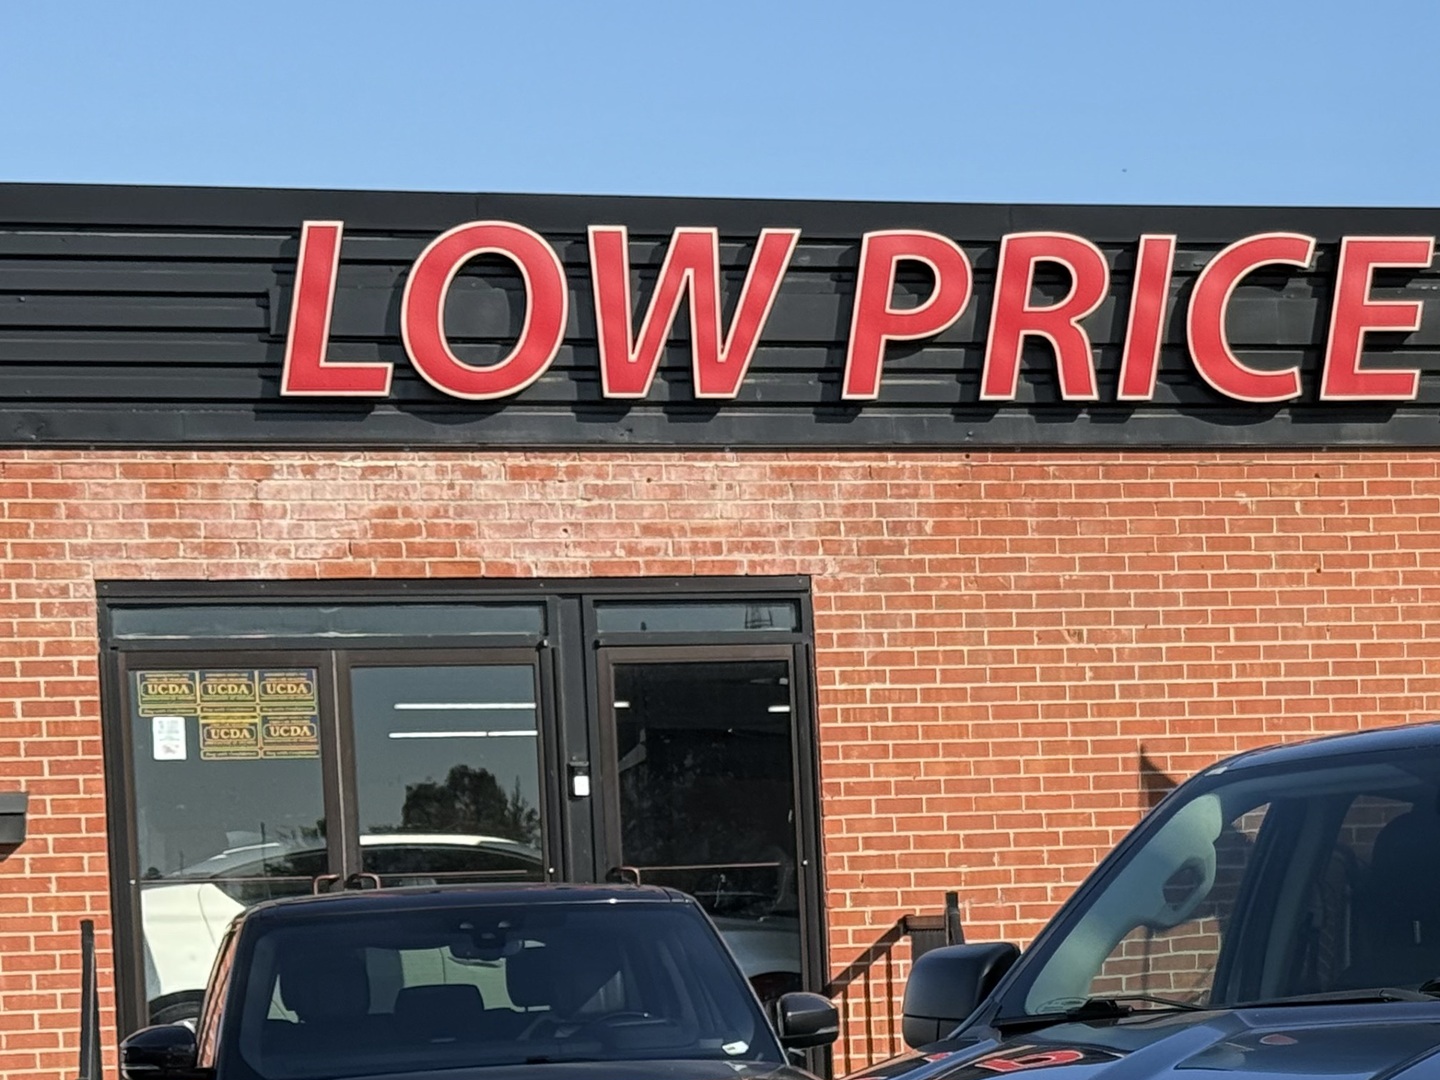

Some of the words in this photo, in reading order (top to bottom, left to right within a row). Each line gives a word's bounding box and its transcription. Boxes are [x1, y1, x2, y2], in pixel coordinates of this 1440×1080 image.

[280, 219, 802, 400] LOW
[841, 229, 1436, 403] PRICE
[147, 683, 190, 695] UCDA
[207, 683, 250, 695] UCDA
[265, 682, 308, 694] UCDA
[210, 728, 252, 740] UCDA
[269, 725, 312, 737] UCDA
